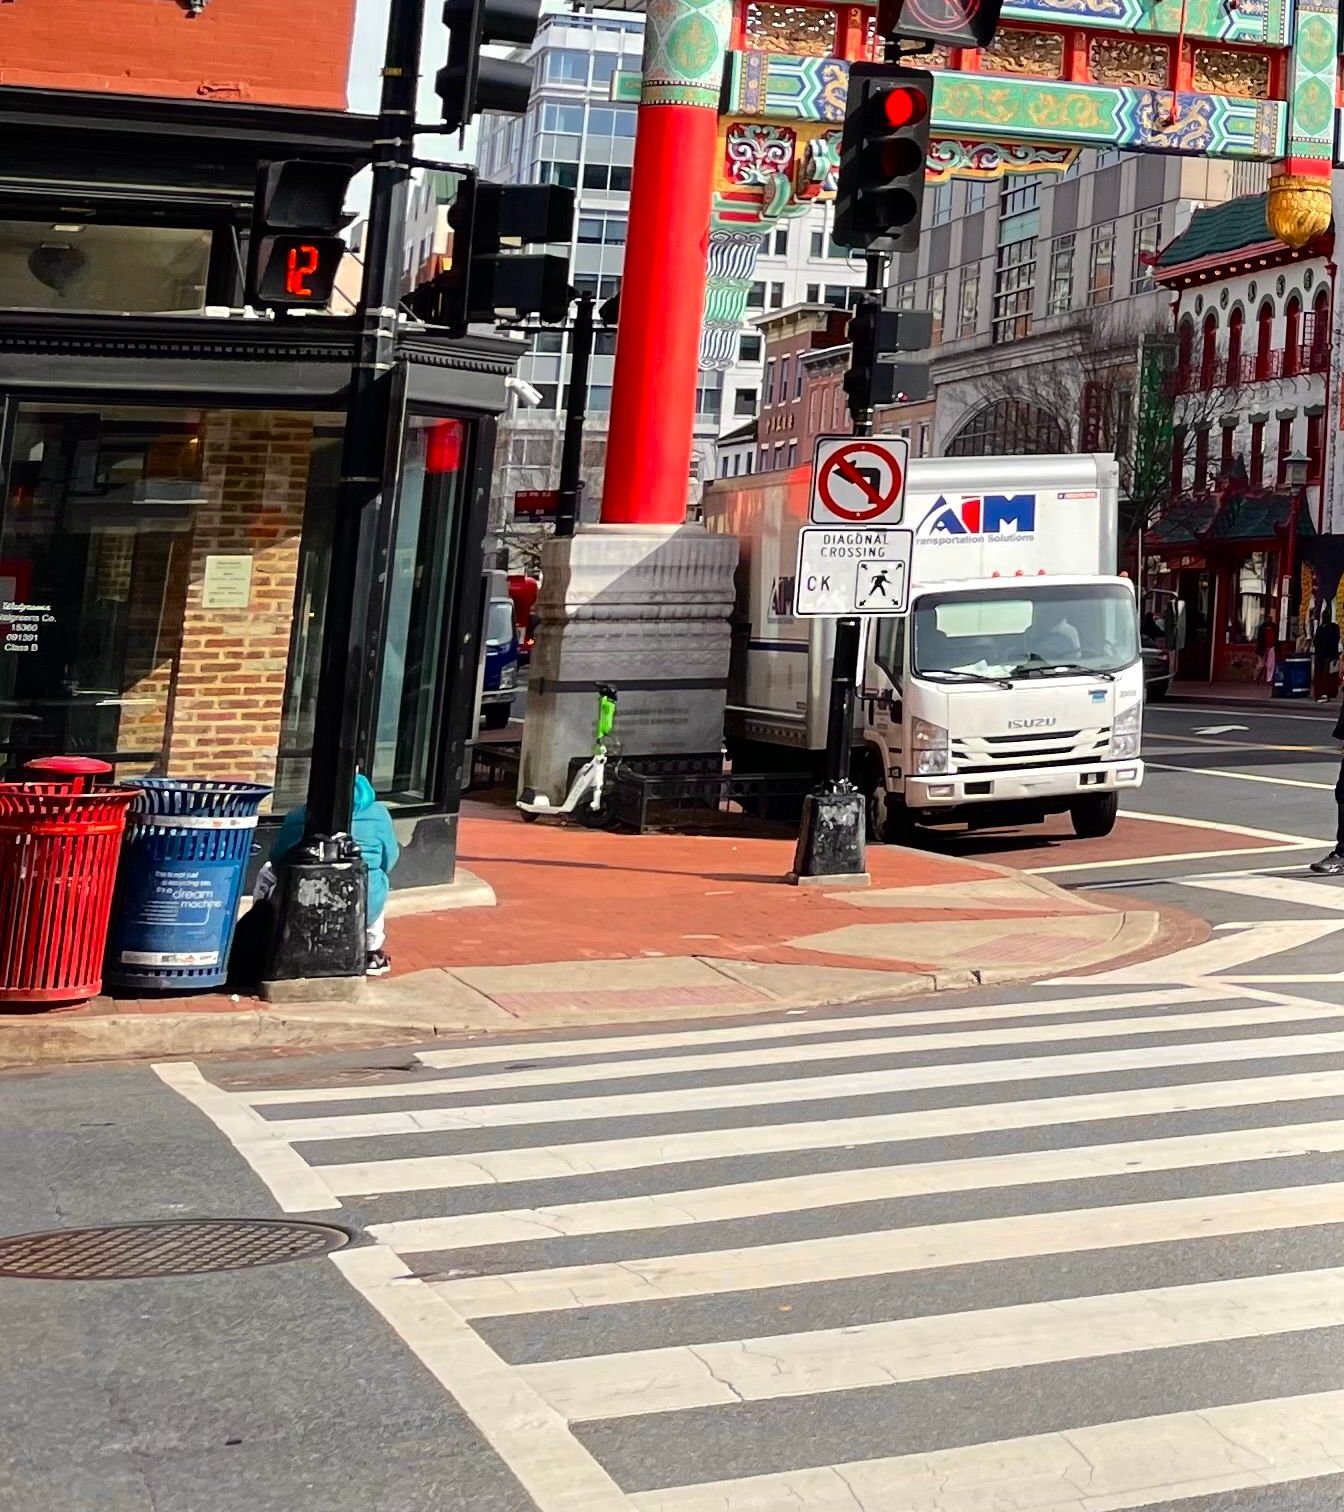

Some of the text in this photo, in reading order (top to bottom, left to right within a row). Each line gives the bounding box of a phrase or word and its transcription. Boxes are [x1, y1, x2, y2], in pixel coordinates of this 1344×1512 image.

[822, 534, 889, 545] DIAGONAL
[916, 533, 1034, 546] ransportation Solutions
[820, 546, 886, 558] CROSSING
[1008, 717, 1057, 730] ISUZU
[172, 888, 214, 900] dream
